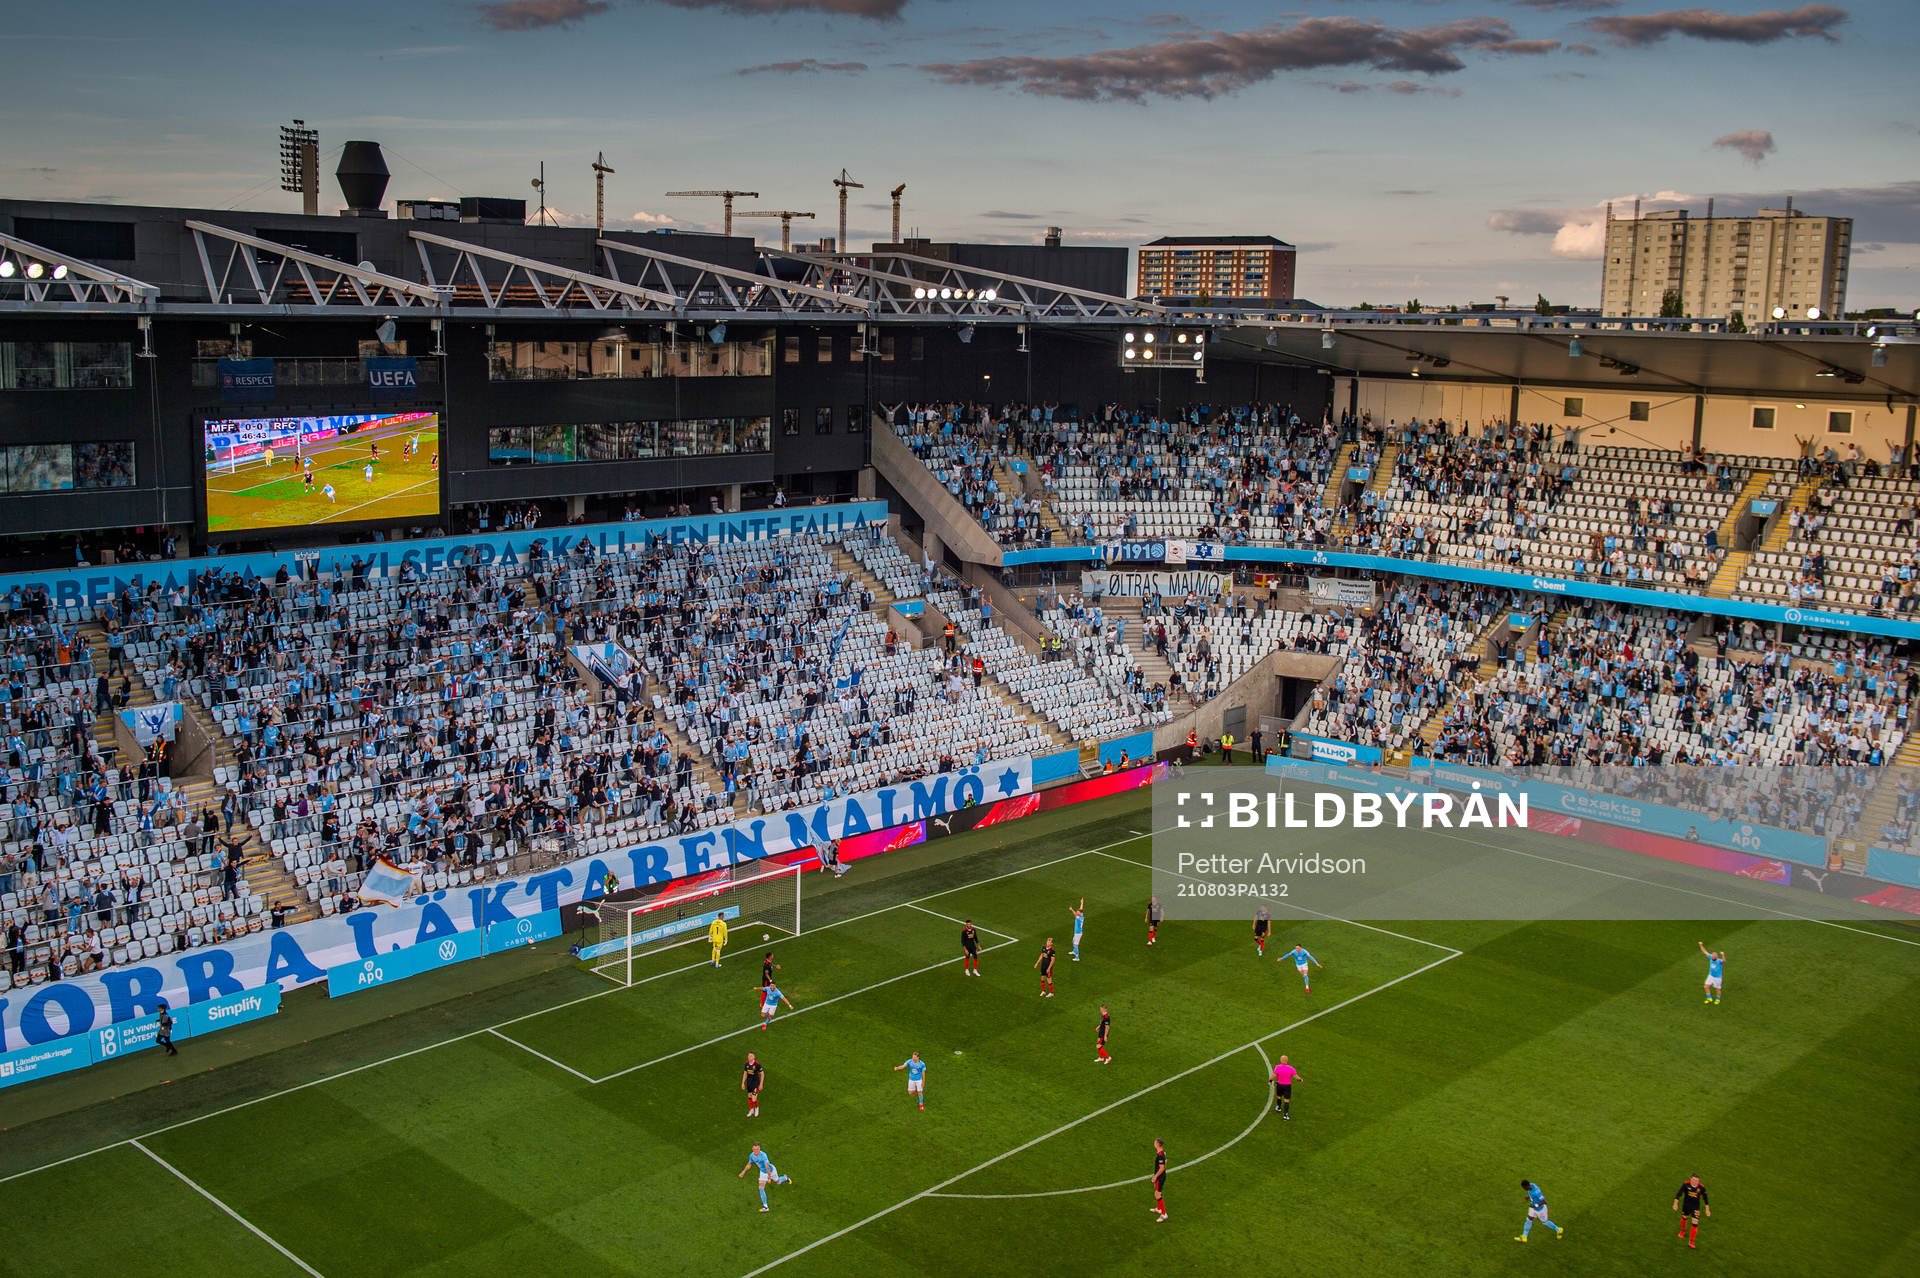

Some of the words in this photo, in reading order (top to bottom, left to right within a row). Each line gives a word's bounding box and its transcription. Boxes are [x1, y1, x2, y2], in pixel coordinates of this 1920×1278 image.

[235, 375, 273, 385] RESPECT
[369, 371, 416, 386] UEFA
[211, 423, 235, 433] MFF
[245, 423, 263, 431] 0-0
[273, 422, 296, 430] RFC
[241, 432, 267, 440] 46:43
[719, 517, 781, 544] INTE
[790, 510, 867, 534] FALLA
[1109, 573, 1159, 597] ØLTRAS
[1803, 615, 1850, 626] CABONLINE
[1578, 797, 1641, 816] exakta
[1732, 833, 1761, 850] ApQ
[346, 820, 777, 959] LÄKTAREN
[784, 766, 984, 845] MALMÖ
[358, 967, 383, 984] ApQ
[207, 996, 262, 1021] Simplify
[123, 1028, 135, 1036] EN
[136, 1017, 178, 1033] VINNAE
